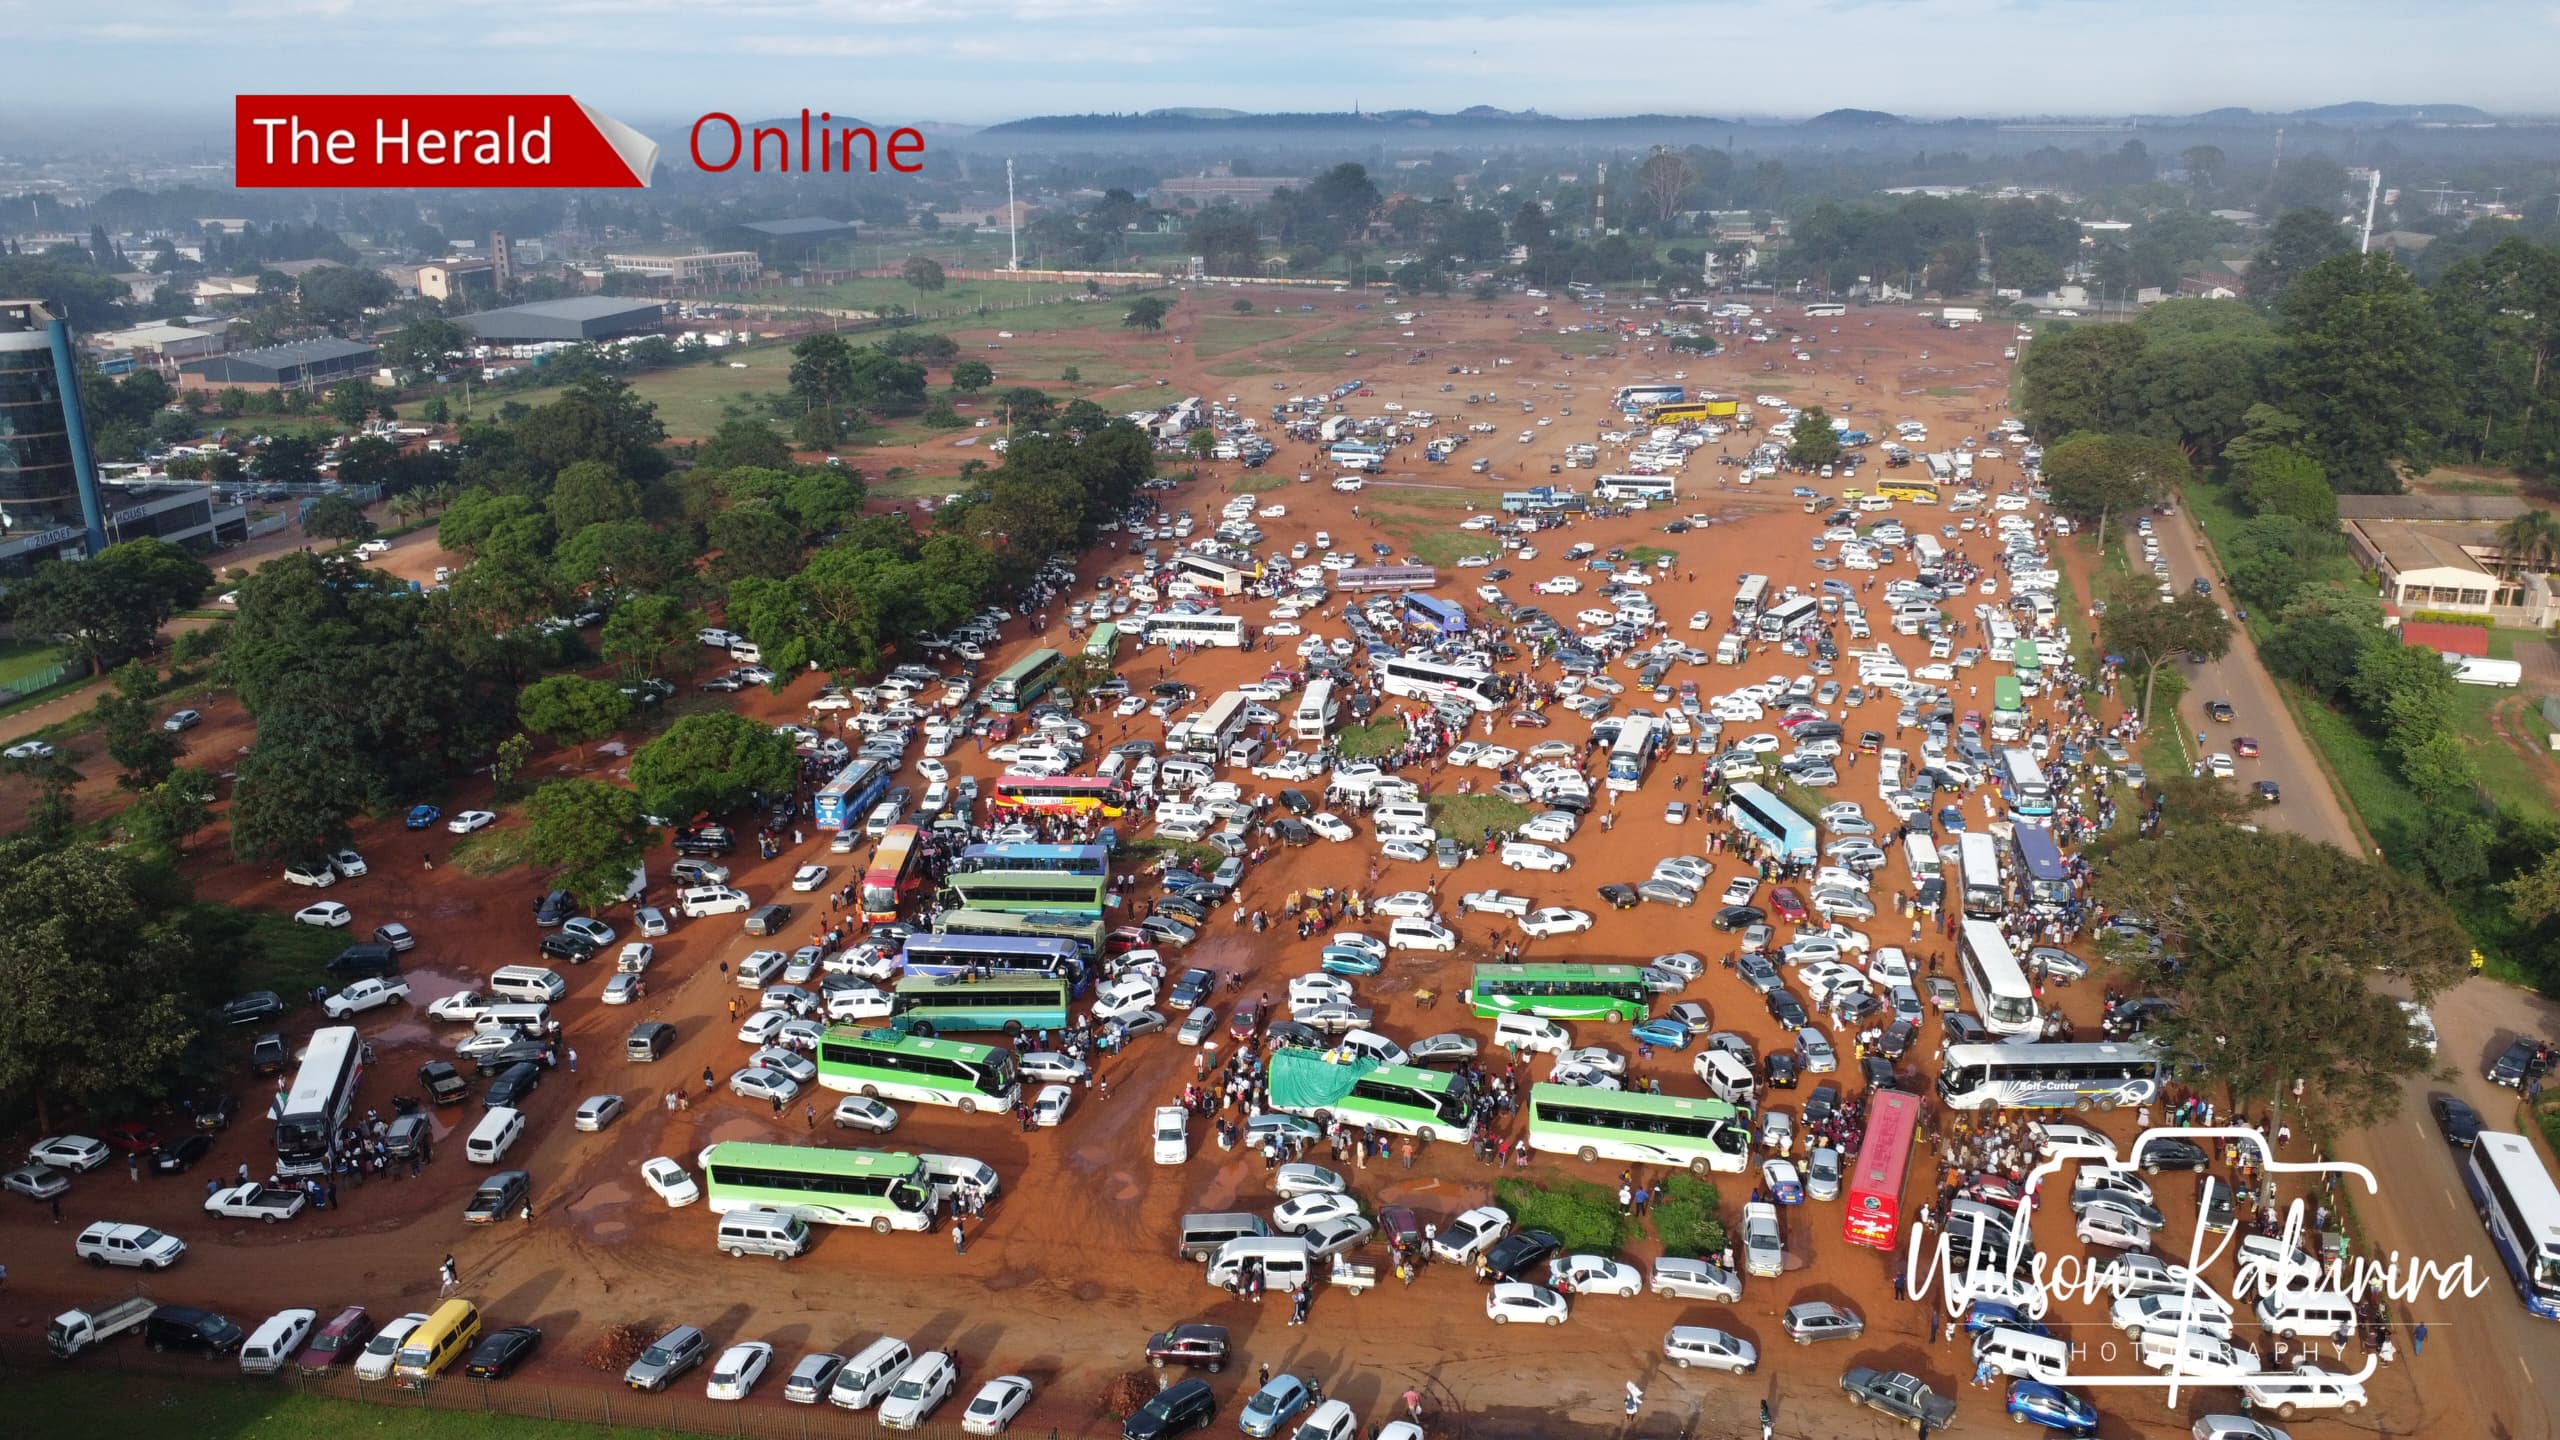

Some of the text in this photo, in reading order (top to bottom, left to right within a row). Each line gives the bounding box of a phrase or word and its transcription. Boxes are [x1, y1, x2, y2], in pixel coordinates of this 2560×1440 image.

[34, 506, 146, 547] ZIMDEF HOUSE
[2020, 1081, 2080, 1091] Bolt-Cutter
